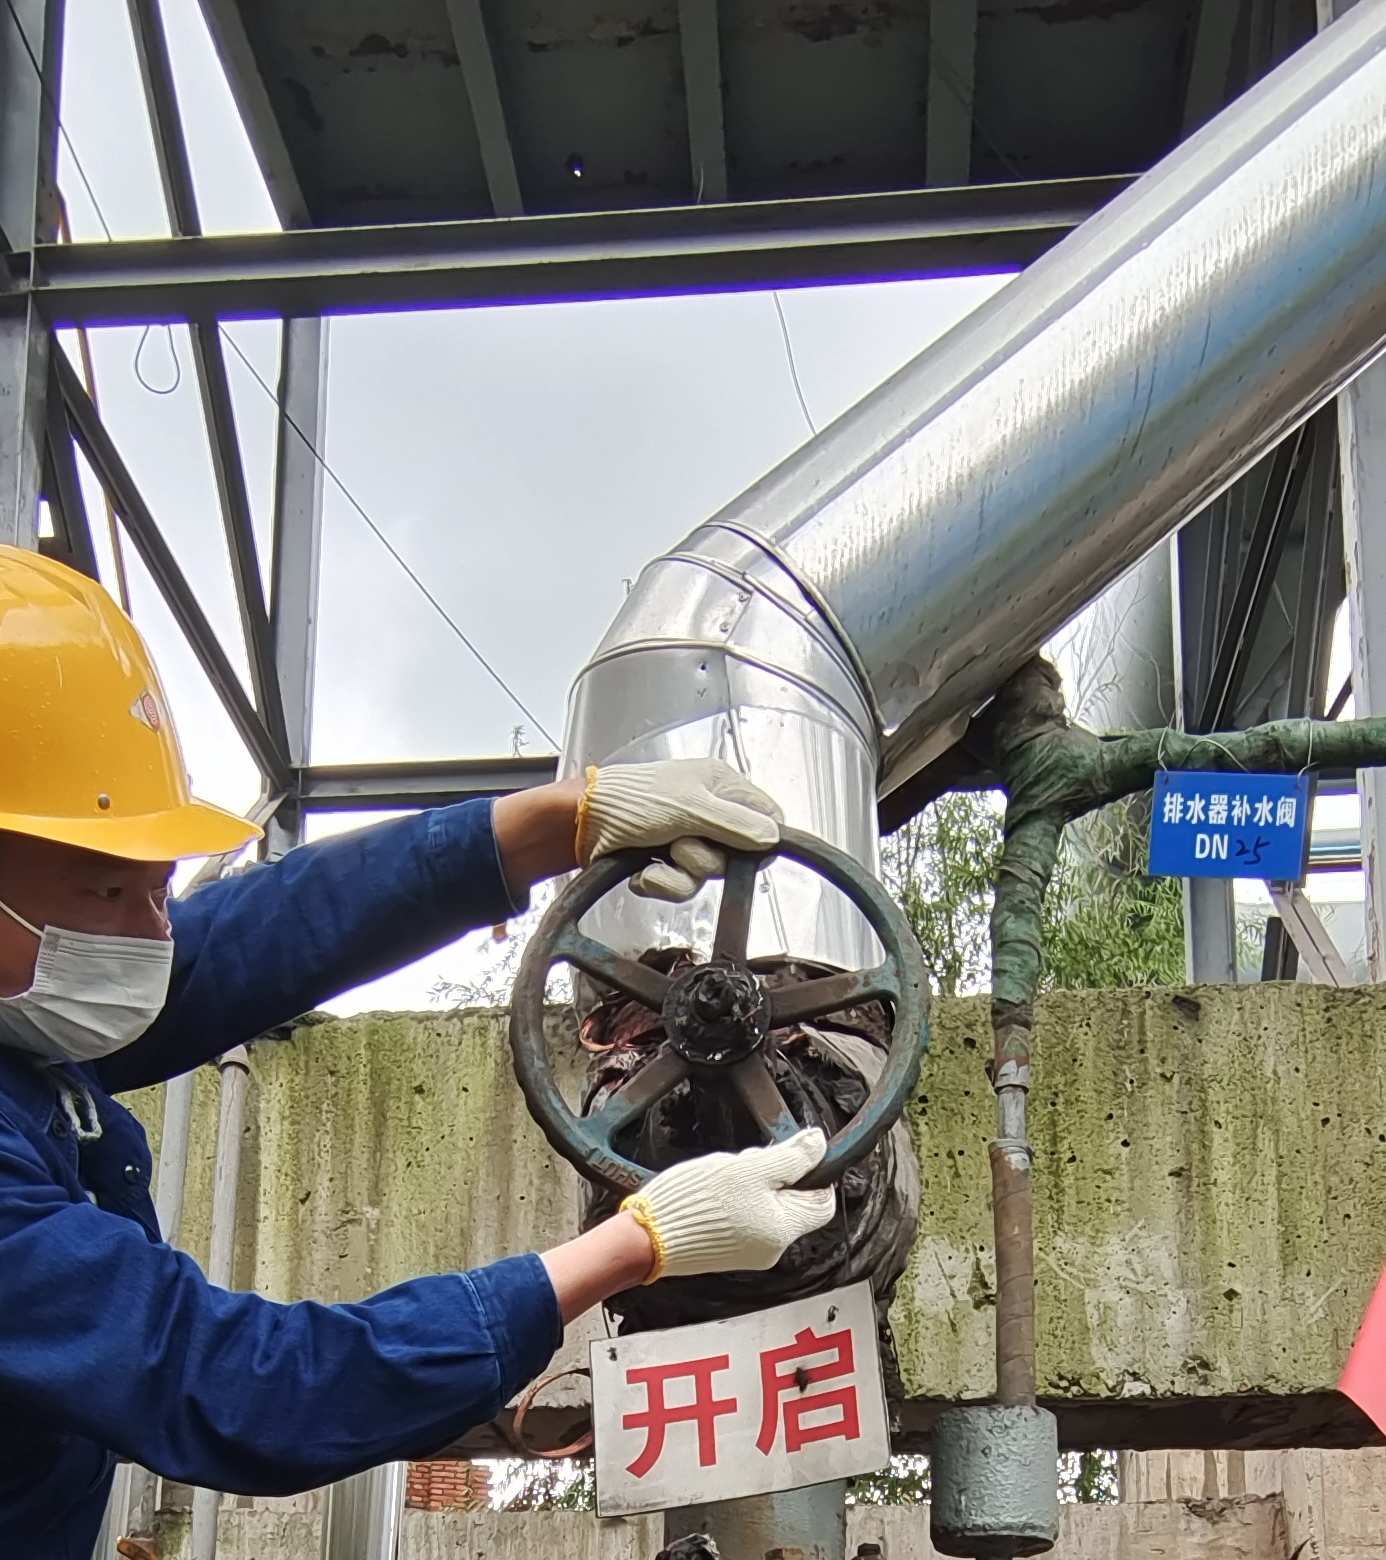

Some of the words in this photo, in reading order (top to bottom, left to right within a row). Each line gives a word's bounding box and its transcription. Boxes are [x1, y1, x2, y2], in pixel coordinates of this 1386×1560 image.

[1163, 792, 1297, 828] 排水器补水阀
[1194, 833, 1229, 860] DN
[1234, 836, 1272, 866] 25
[622, 1326, 861, 1479] 开启
